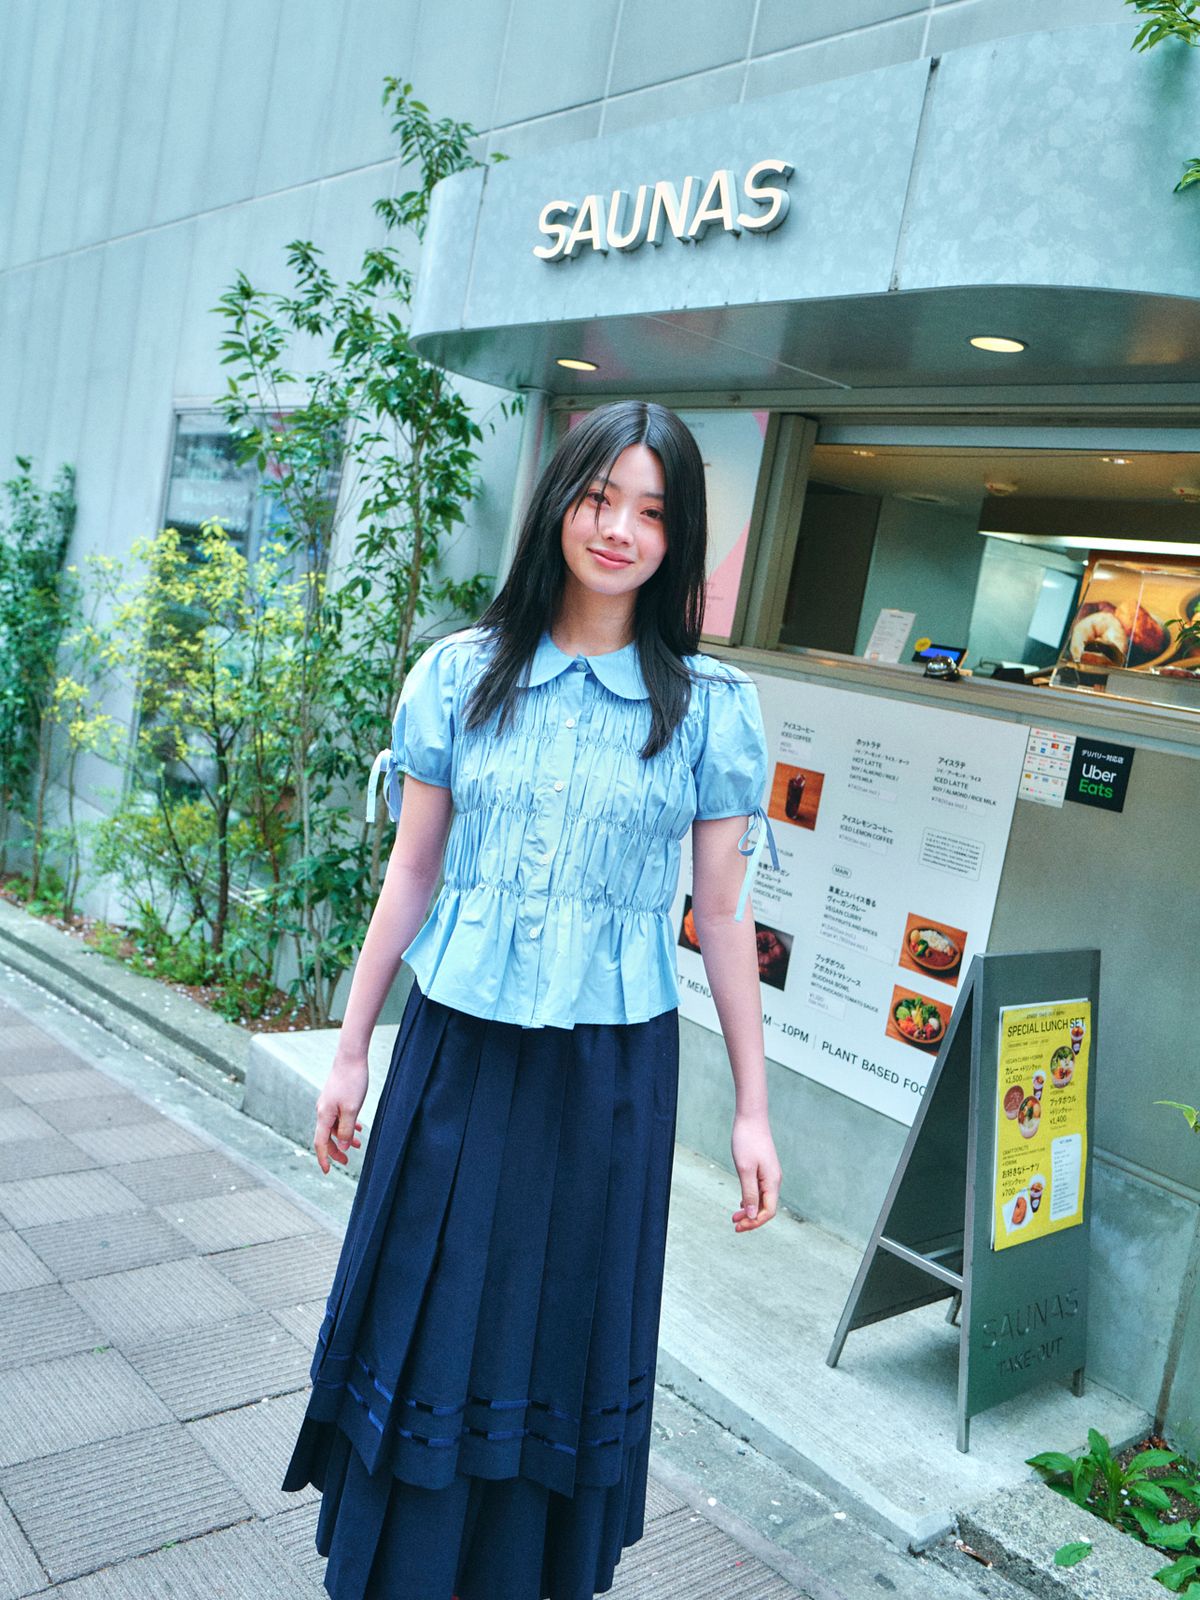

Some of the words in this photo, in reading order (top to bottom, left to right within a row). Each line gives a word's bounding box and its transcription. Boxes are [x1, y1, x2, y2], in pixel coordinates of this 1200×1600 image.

[533, 159, 795, 262] SAUNAS
[782, 721, 816, 734] アイスコーヒー
[780, 731, 792, 739] ICED
[793, 733, 812, 743] COFFEE
[856, 738, 881, 750] ホットラテ
[852, 757, 864, 765] HOT
[864, 760, 882, 769] LATTE
[938, 756, 966, 769] アイスラテ
[1082, 763, 1117, 783] Uber
[934, 776, 949, 785] ICED
[949, 779, 968, 790] LATTE
[1079, 779, 1114, 799] Eats
[946, 788, 968, 799] ALMOND
[971, 793, 982, 803] RICE
[841, 814, 894, 834] アイスレモンコーヒー
[840, 823, 853, 833] ICED
[853, 828, 872, 839] LEMON
[872, 833, 894, 845] COFFEE
[834, 866, 849, 876] MAIN
[752, 887, 781, 902] CHOCOLATE
[825, 904, 844, 916] VEGAN
[844, 910, 862, 921] CURRY
[687, 979, 712, 998] MENU
[1007, 1022, 1039, 1038] SPECIAL
[1040, 1018, 1069, 1033] LUNCH
[1070, 1016, 1086, 1029] SET
[821, 1041, 858, 1065] PLANT
[861, 1059, 900, 1084] BASED
[903, 1078, 927, 1097] FOO
[982, 1287, 1080, 1350] SAUNAS
